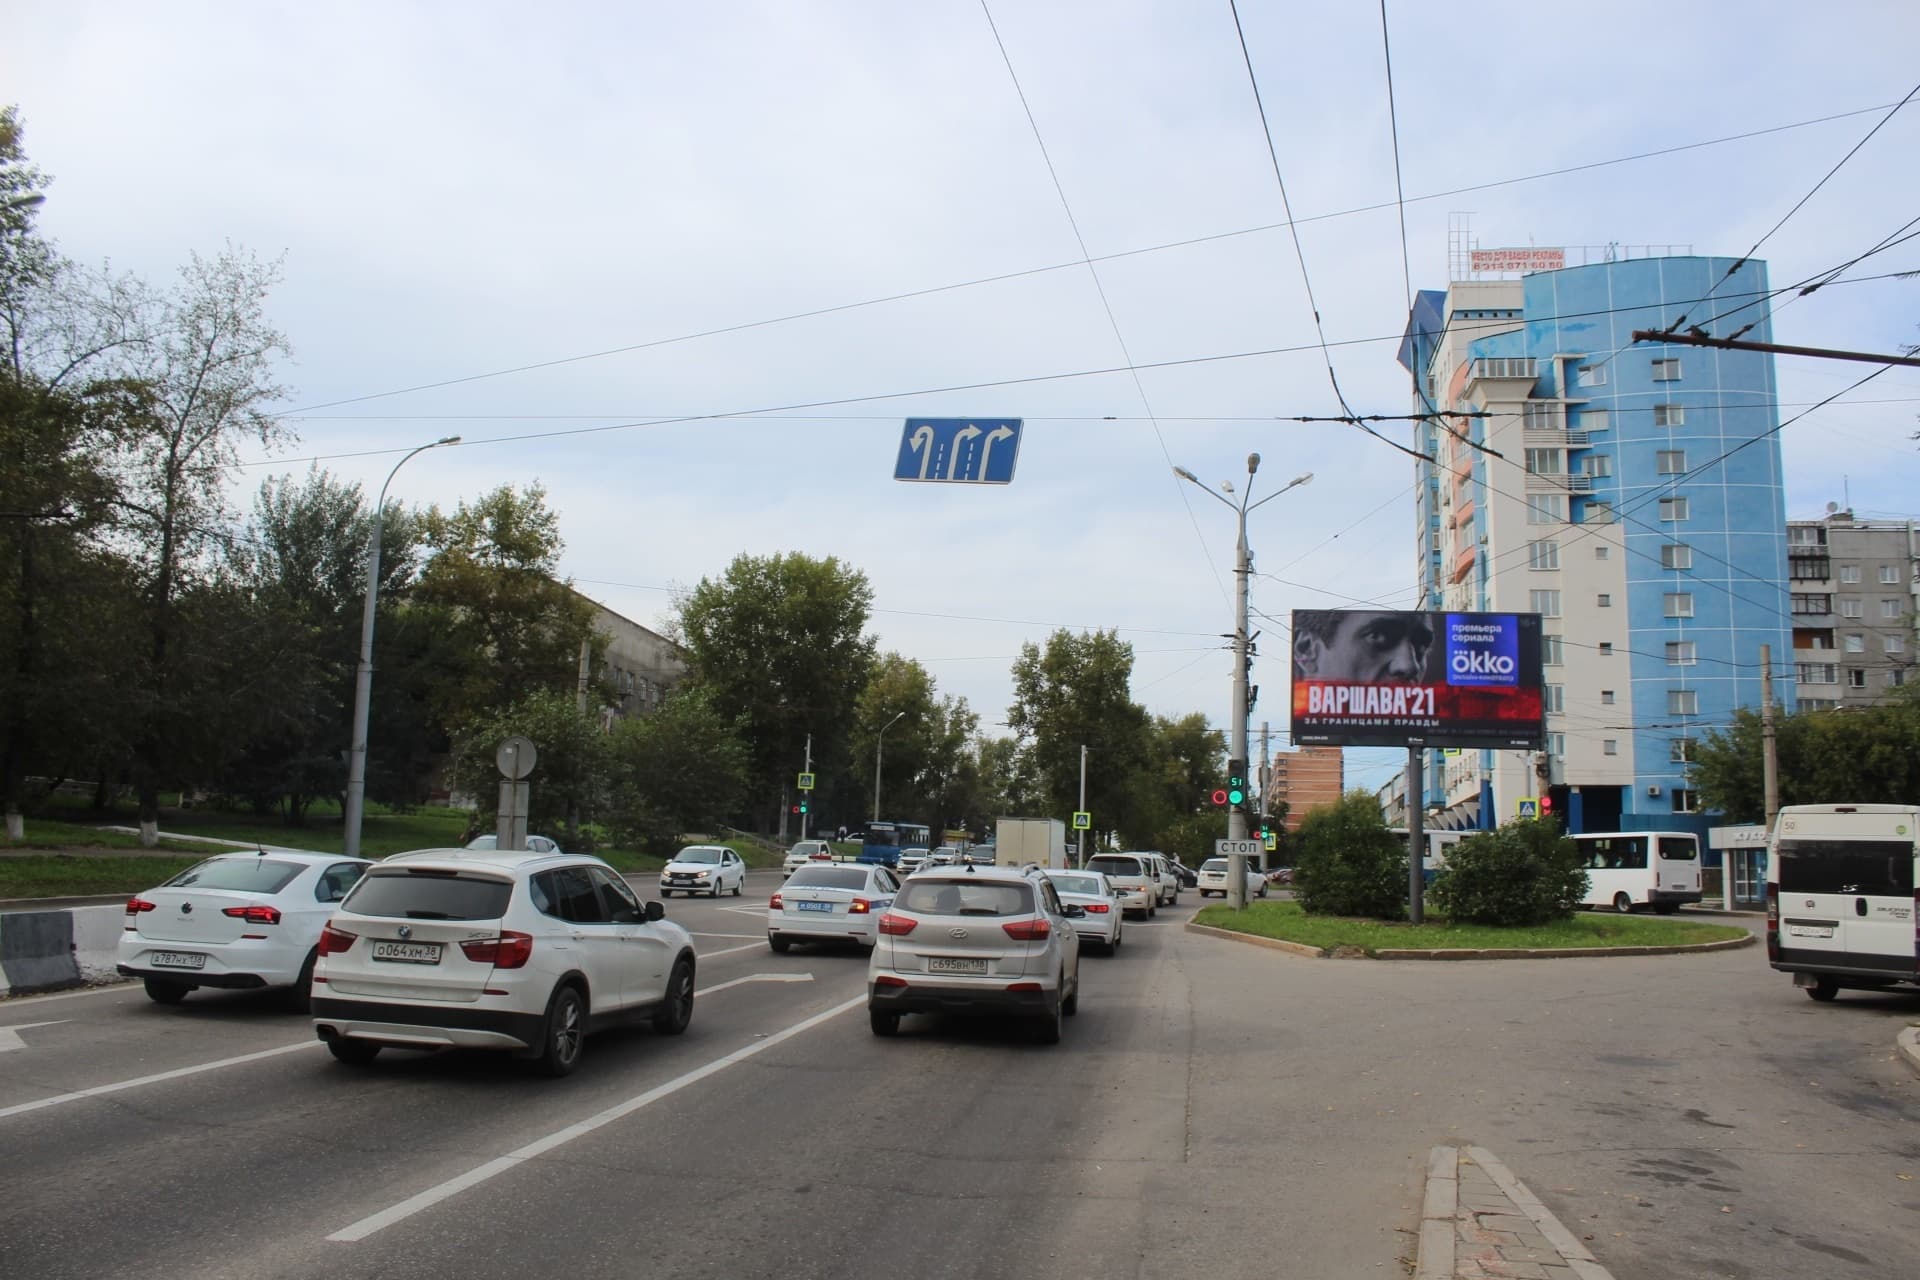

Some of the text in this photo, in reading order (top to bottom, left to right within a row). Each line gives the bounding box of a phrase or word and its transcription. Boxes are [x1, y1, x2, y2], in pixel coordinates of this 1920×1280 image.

[1452, 624, 1502, 633] премьера
[1452, 634, 1495, 643] сериала
[1304, 717, 1440, 727] ЗА ГРАНИЦАМИ ПРАВДЫ
[1221, 842, 1257, 853] СТОП
